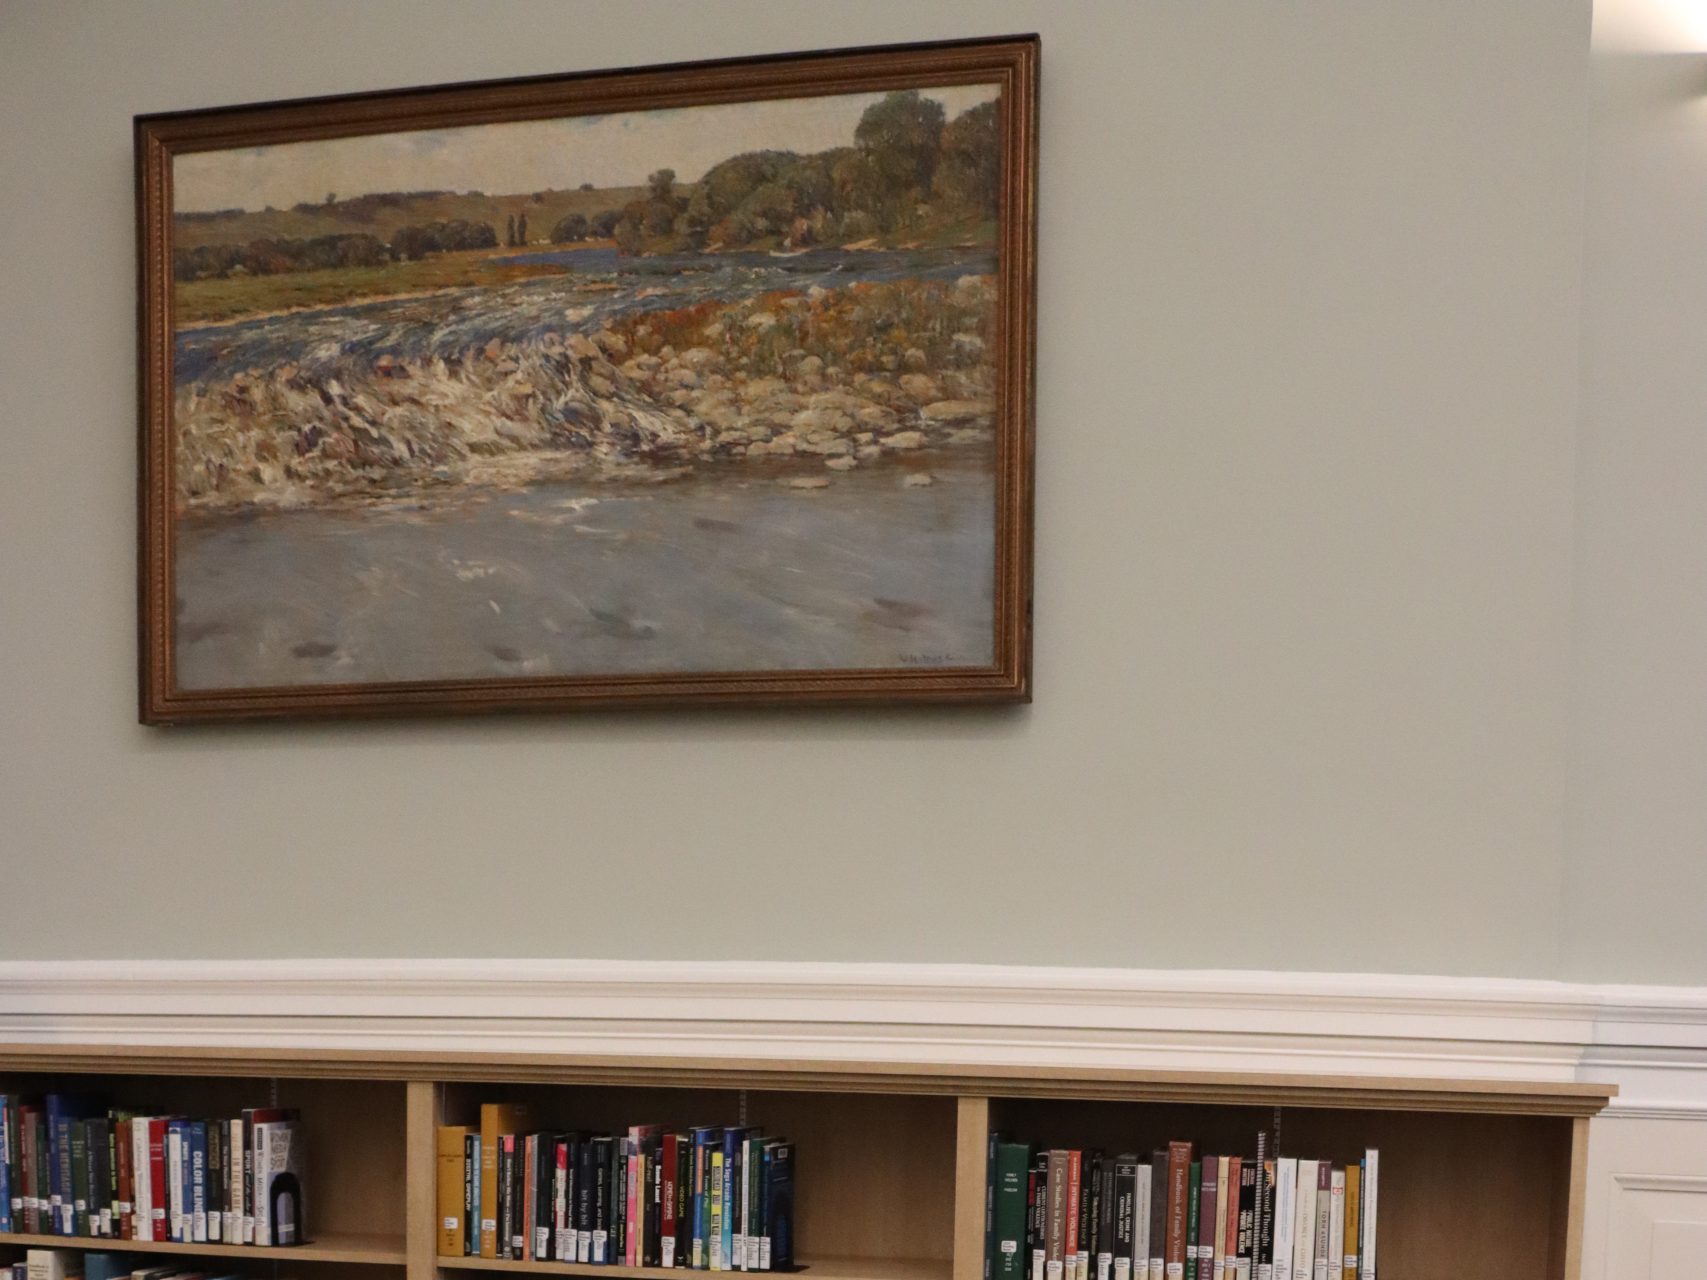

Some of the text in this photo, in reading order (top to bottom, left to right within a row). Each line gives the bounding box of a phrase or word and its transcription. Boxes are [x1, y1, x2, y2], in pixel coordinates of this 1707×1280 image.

[193, 1150, 203, 1183] COLOR
[723, 1168, 731, 1181] Sega
[1055, 1168, 1063, 1183] Case
[1054, 1185, 1062, 1208] Studies
[1175, 1169, 1183, 1204] Handbook
[1264, 1183, 1272, 1212] Second
[579, 1202, 587, 1213] by
[1069, 1186, 1077, 1214] INTIMATE
[1175, 1206, 1182, 1214] of
[1051, 1218, 1061, 1240] Family
[1173, 1216, 1182, 1237] Family
[1261, 1214, 1271, 1247] Thought
[1238, 1232, 1246, 1254] VIOLENCE
